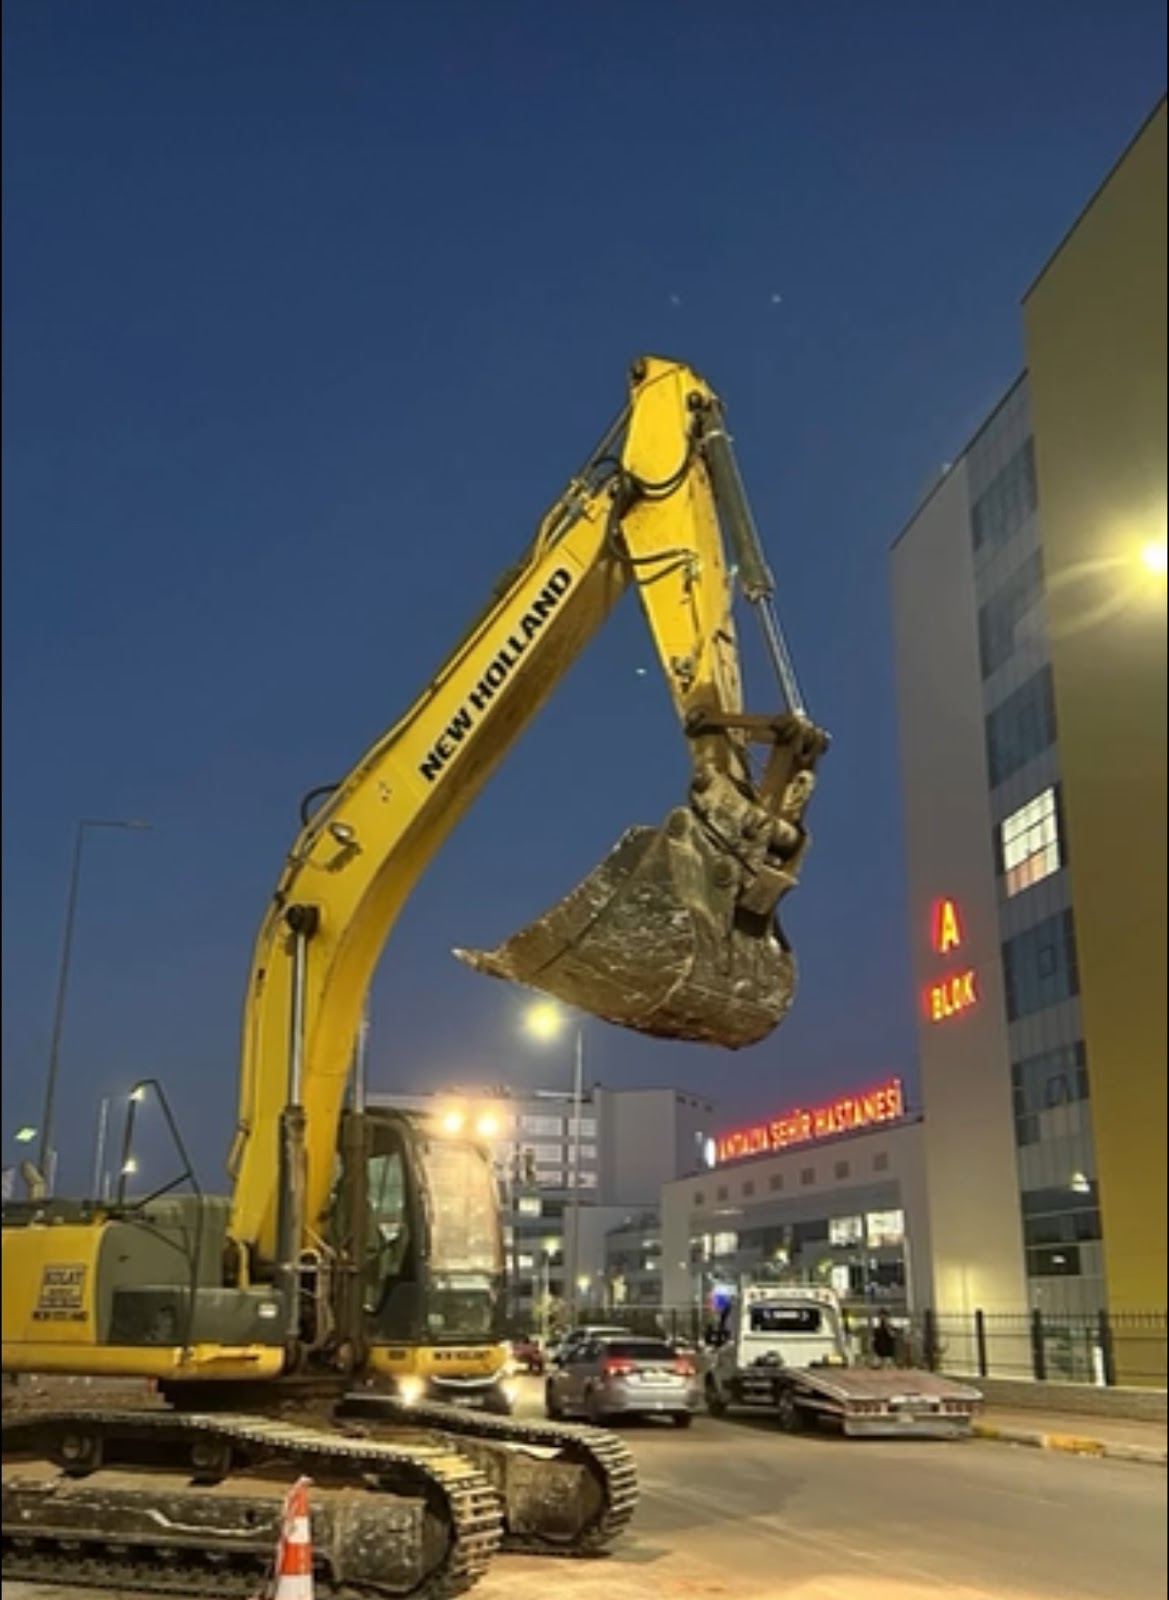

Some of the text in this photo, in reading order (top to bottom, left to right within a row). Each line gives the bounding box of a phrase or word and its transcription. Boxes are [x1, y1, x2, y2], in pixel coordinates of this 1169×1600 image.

[418, 567, 572, 782] NEW HOLLAND
[937, 899, 961, 954] A
[929, 970, 977, 1021] BLOK
[813, 1078, 903, 1138] HASTANESİ
